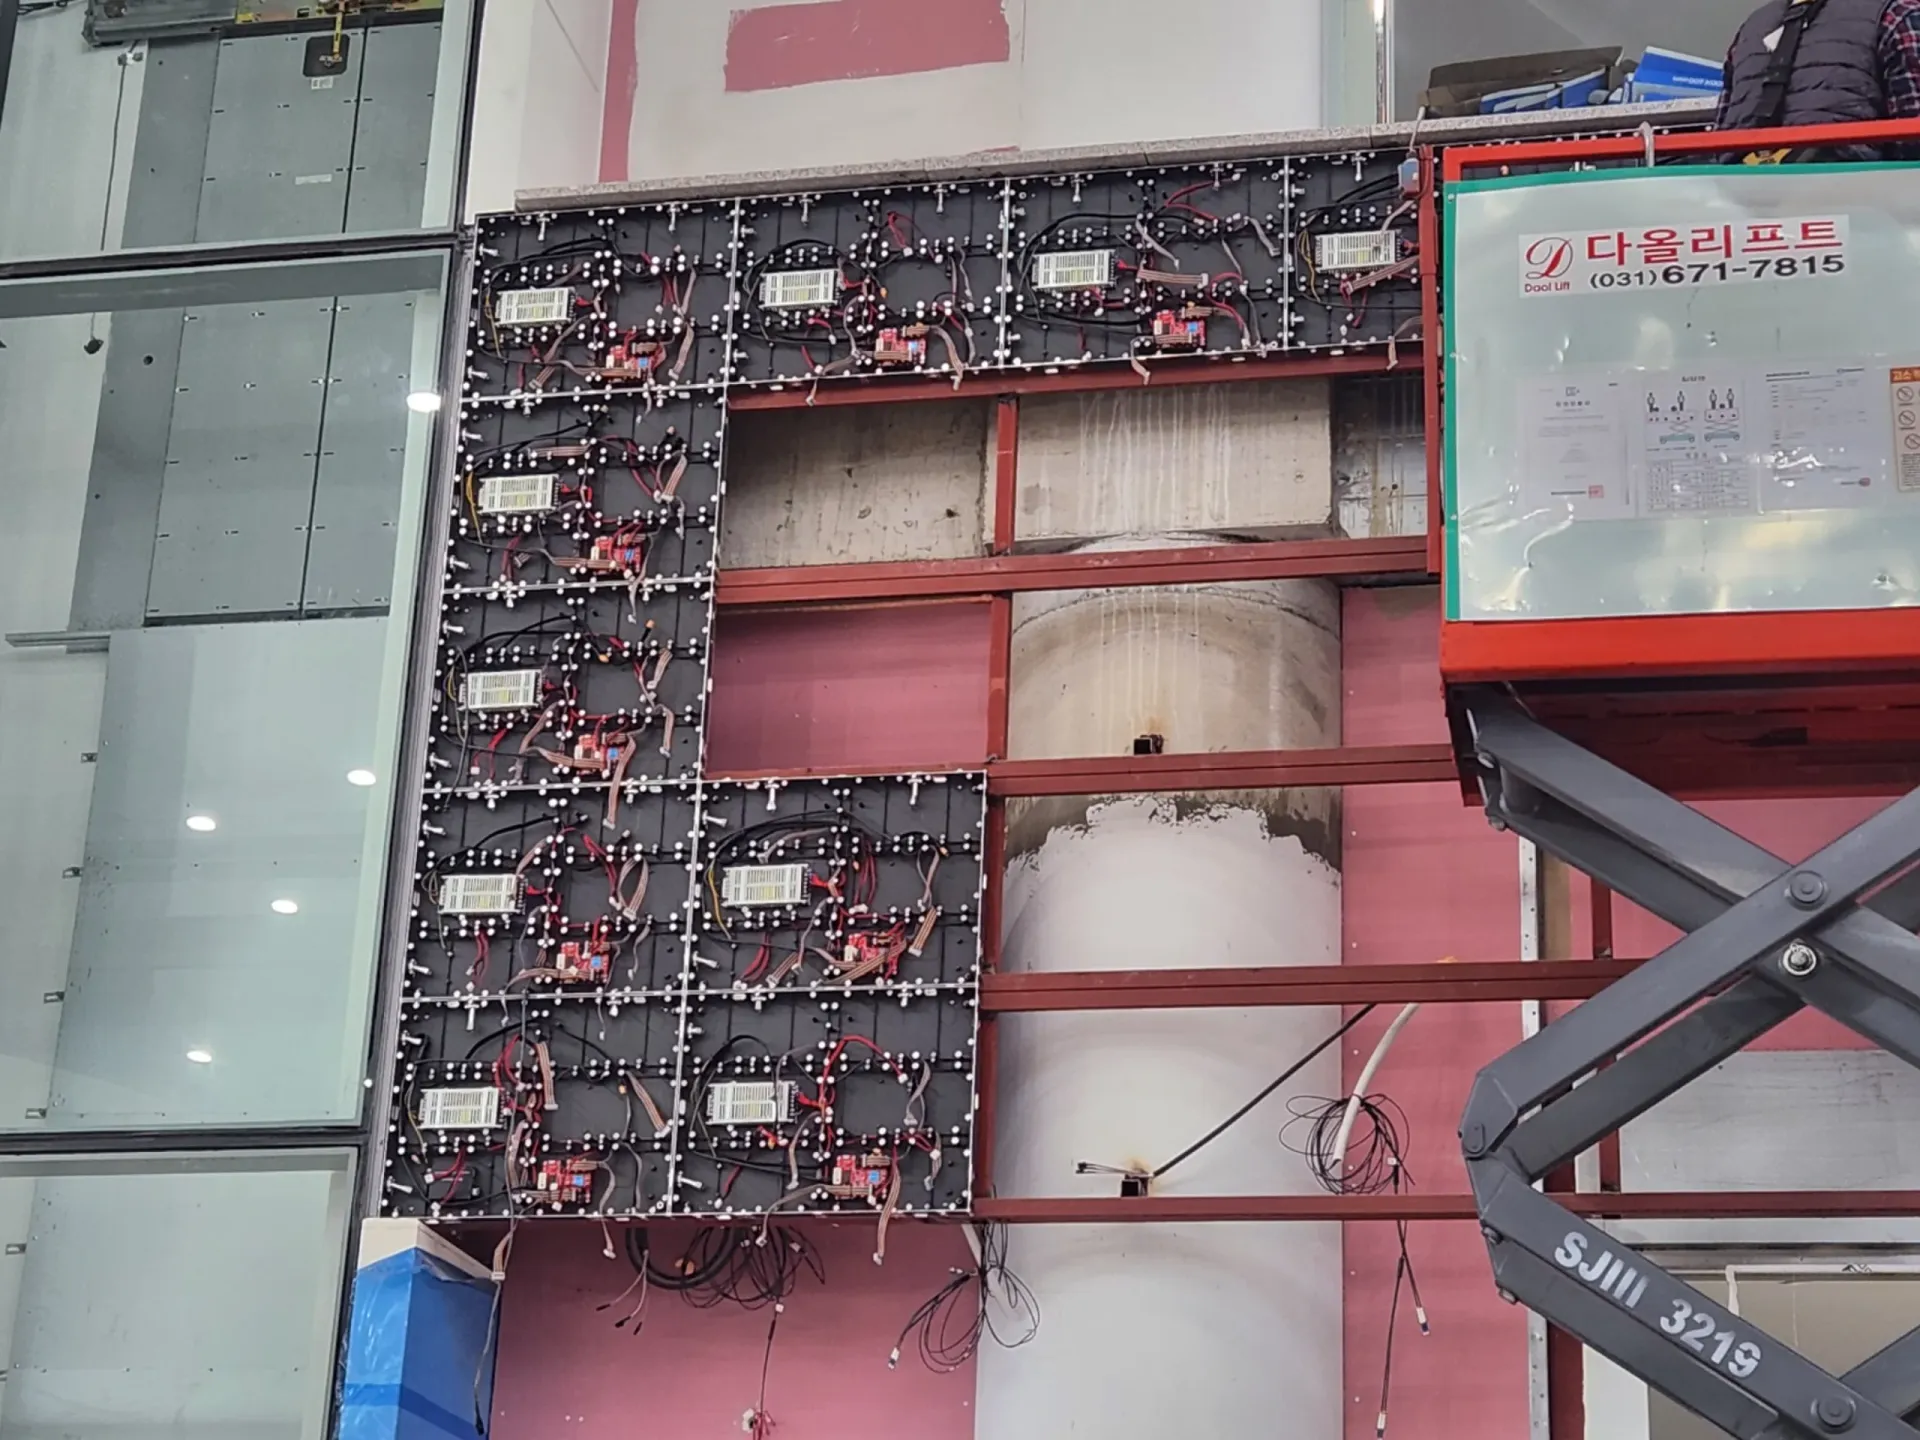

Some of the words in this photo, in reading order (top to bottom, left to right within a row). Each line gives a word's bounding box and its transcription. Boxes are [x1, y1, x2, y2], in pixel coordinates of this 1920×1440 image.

[1585, 221, 1843, 266] 다올리프트
[1524, 283, 1552, 293] Daol
[1555, 281, 1571, 291] Lift
[1590, 254, 1845, 289] (031)671-7815
[1659, 1298, 1762, 1378] 3219
